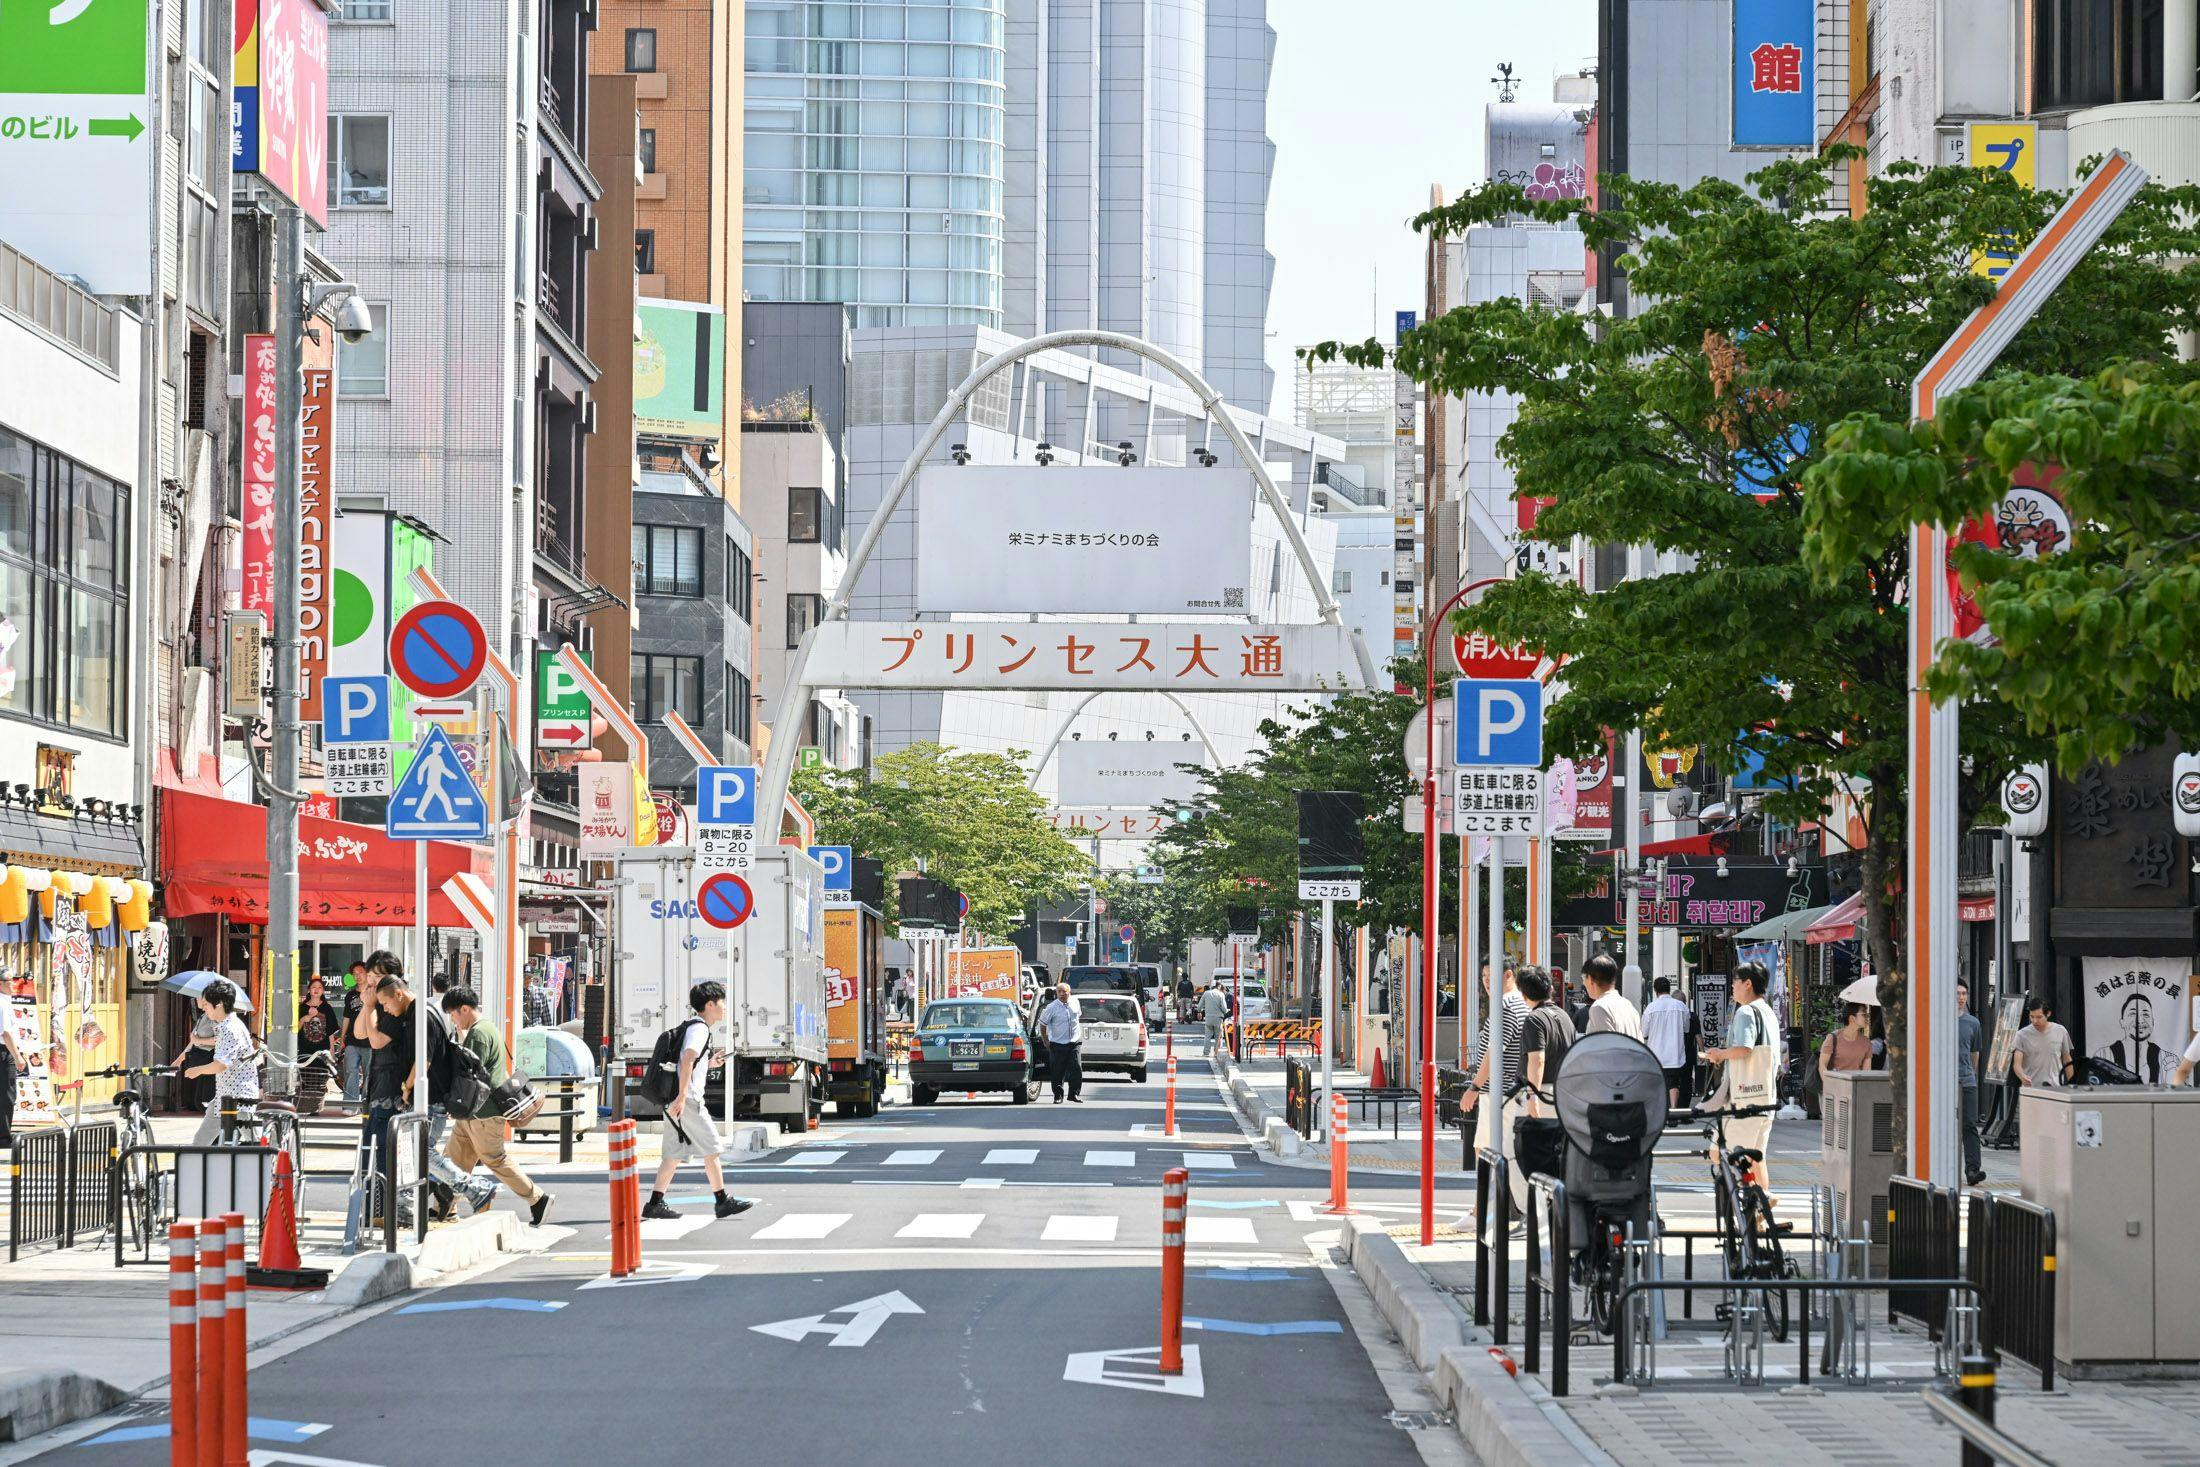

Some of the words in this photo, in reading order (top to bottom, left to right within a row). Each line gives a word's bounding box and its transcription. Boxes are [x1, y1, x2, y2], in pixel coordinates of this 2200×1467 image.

[1751, 43, 1802, 94] 館
[1, 115, 79, 140] のビル
[1008, 531, 1160, 548] 栄ミナミまちづくりの会
[1186, 600, 1221, 608] お問合せ先
[250, 627, 260, 696] 防犯カメラ作動中
[881, 628, 1285, 679] プリンセス大通
[340, 683, 377, 736] P
[543, 709, 578, 717] プリンセス
[1478, 689, 1526, 757] P
[327, 747, 388, 762] 自転車に限る
[333, 780, 384, 793] ここまで
[1460, 774, 1538, 791] 自転車に限る
[713, 772, 745, 819] P
[582, 824, 627, 838] 矢場とん
[1466, 816, 1532, 832] ここまで
[699, 828, 753, 841] 貨物に限る
[703, 856, 748, 868] ここから
[1308, 887, 1351, 897] ここから
[1685, 900, 1766, 924] 취할래?
[2094, 971, 2181, 1000] 酒は百薬の長
